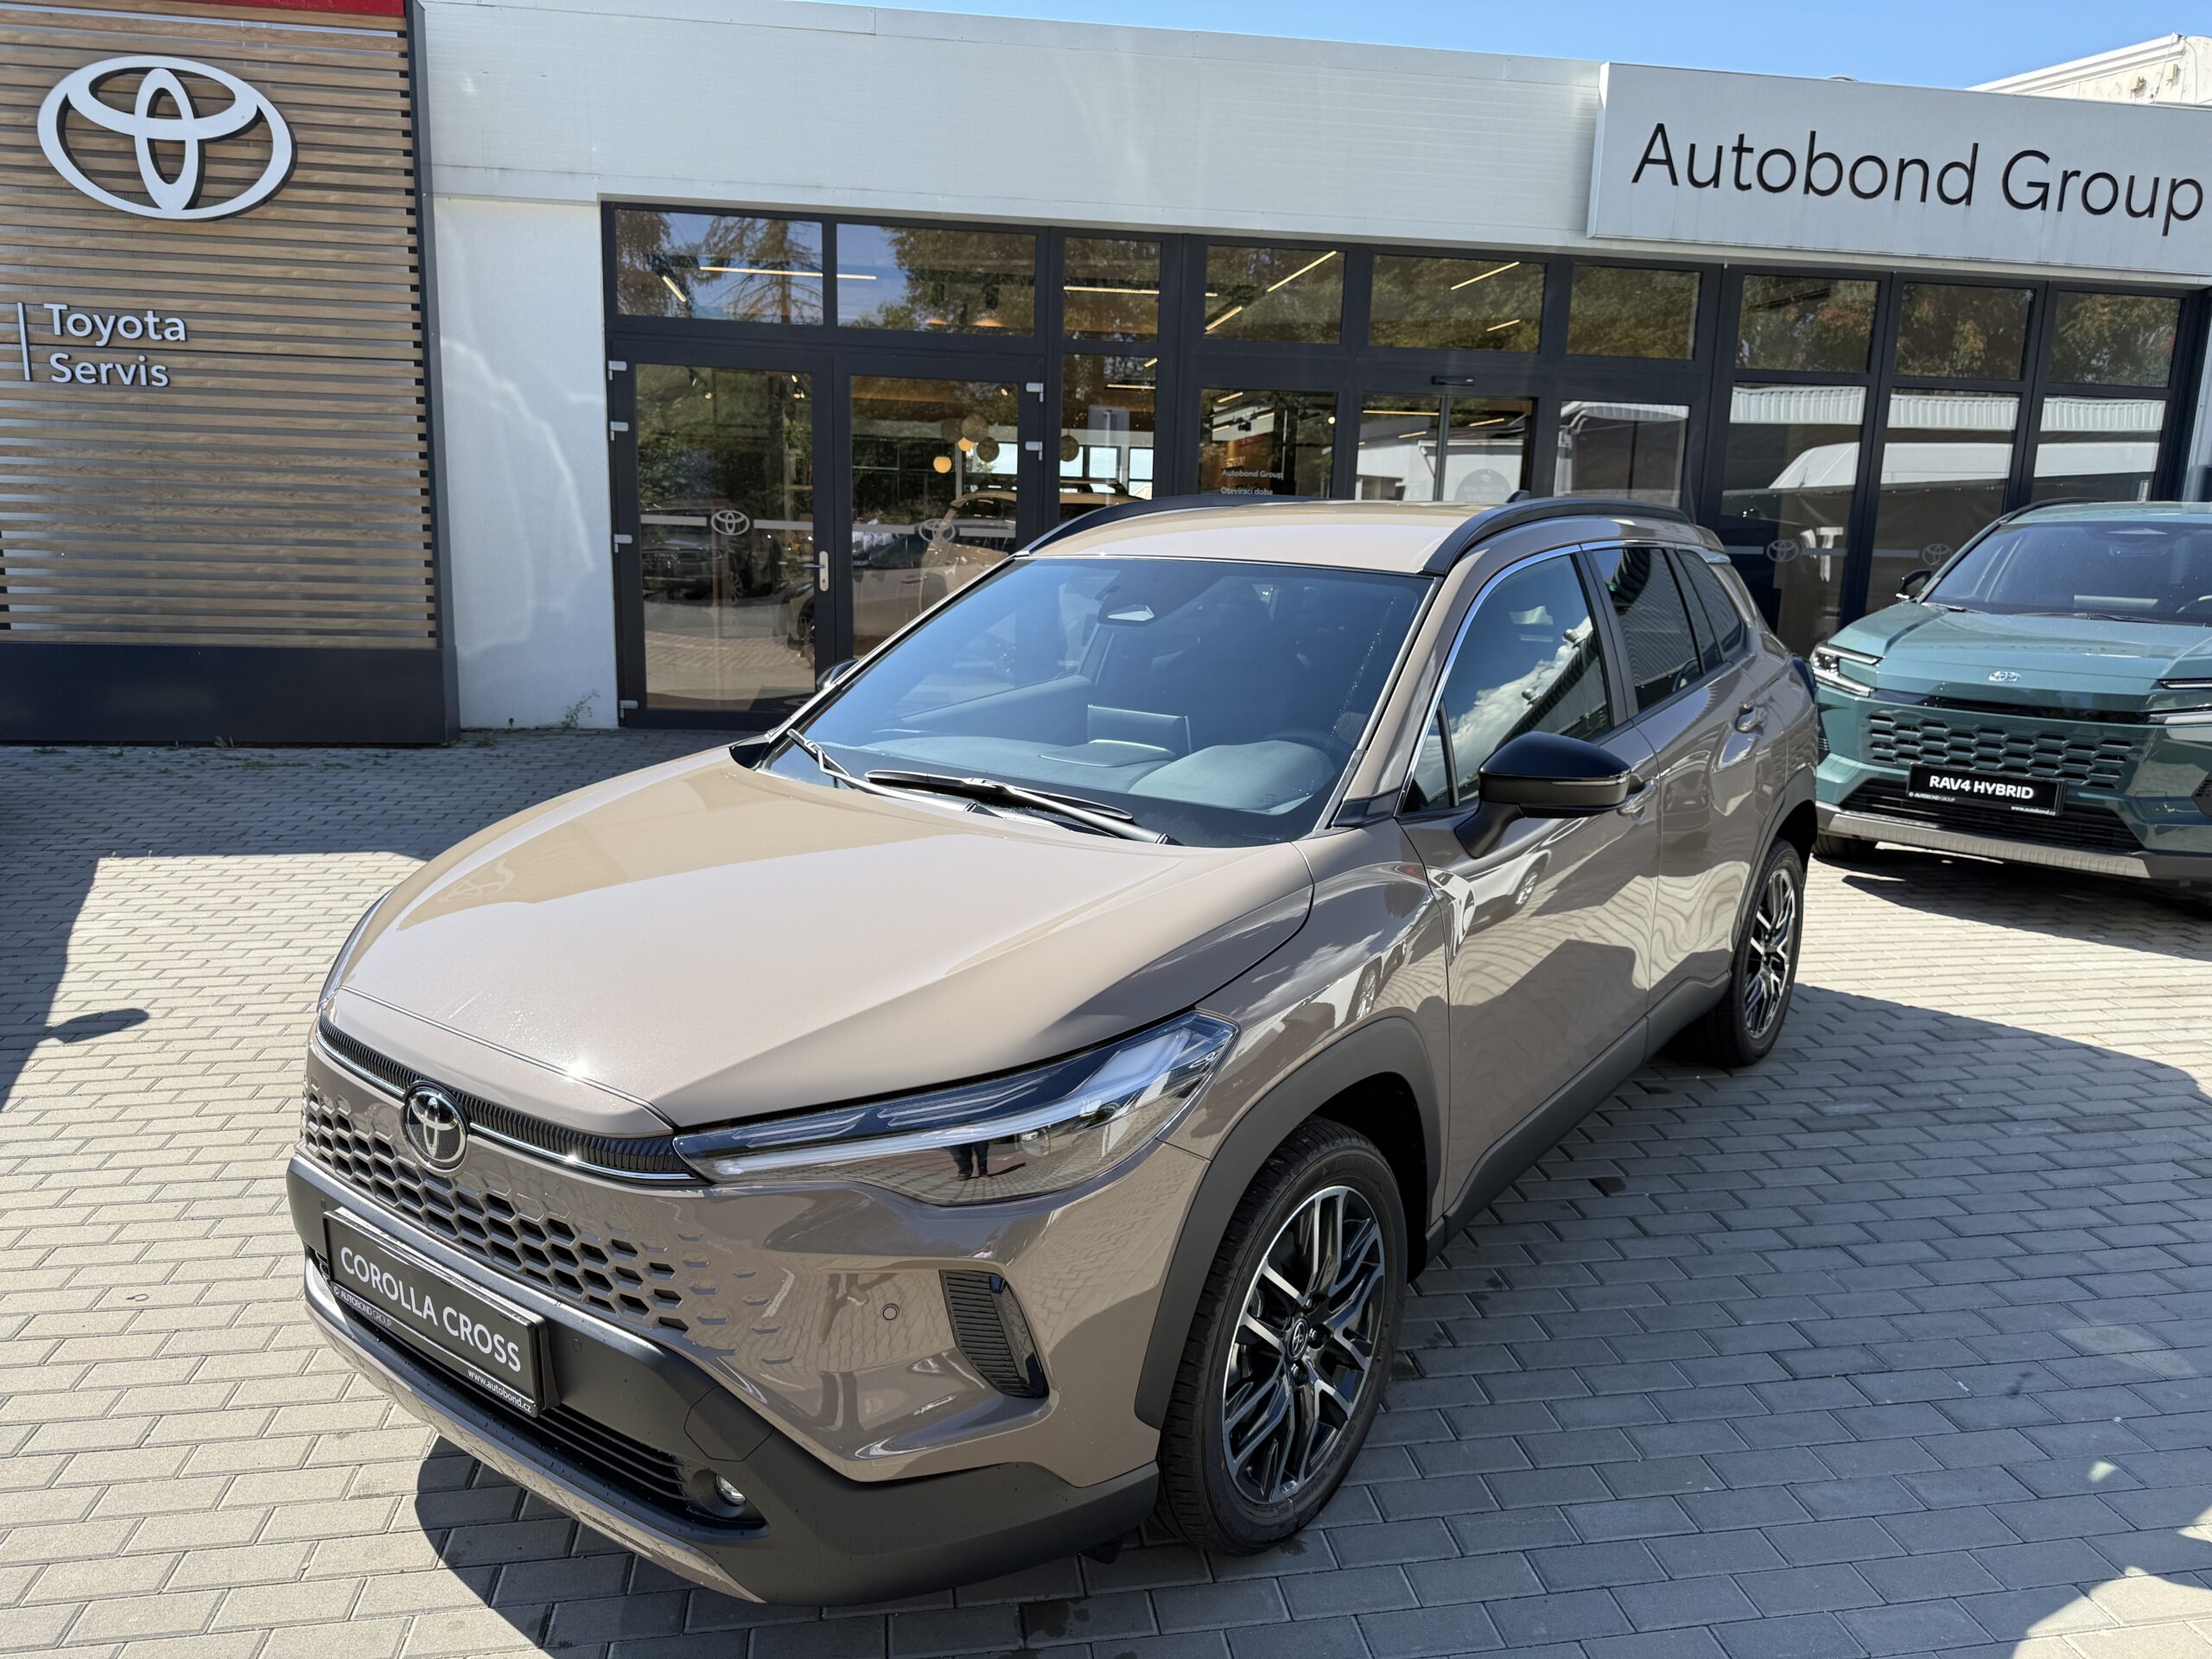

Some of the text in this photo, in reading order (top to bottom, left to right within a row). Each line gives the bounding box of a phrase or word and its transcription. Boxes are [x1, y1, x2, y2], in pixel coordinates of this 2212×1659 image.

[1631, 123, 2204, 237] Autobond Group
[43, 302, 188, 347] Toyota
[49, 352, 170, 388] Servis
[1222, 469, 1284, 480] Autobond Group
[1929, 775, 2035, 800] RAV4 HYBRID
[2010, 805, 2056, 817] www.autobond.cz
[340, 1290, 392, 1327] AUTOBOND GROUP
[340, 1246, 522, 1372] COROLLA CROSS
[467, 1368, 532, 1414] www.autobond.cz
